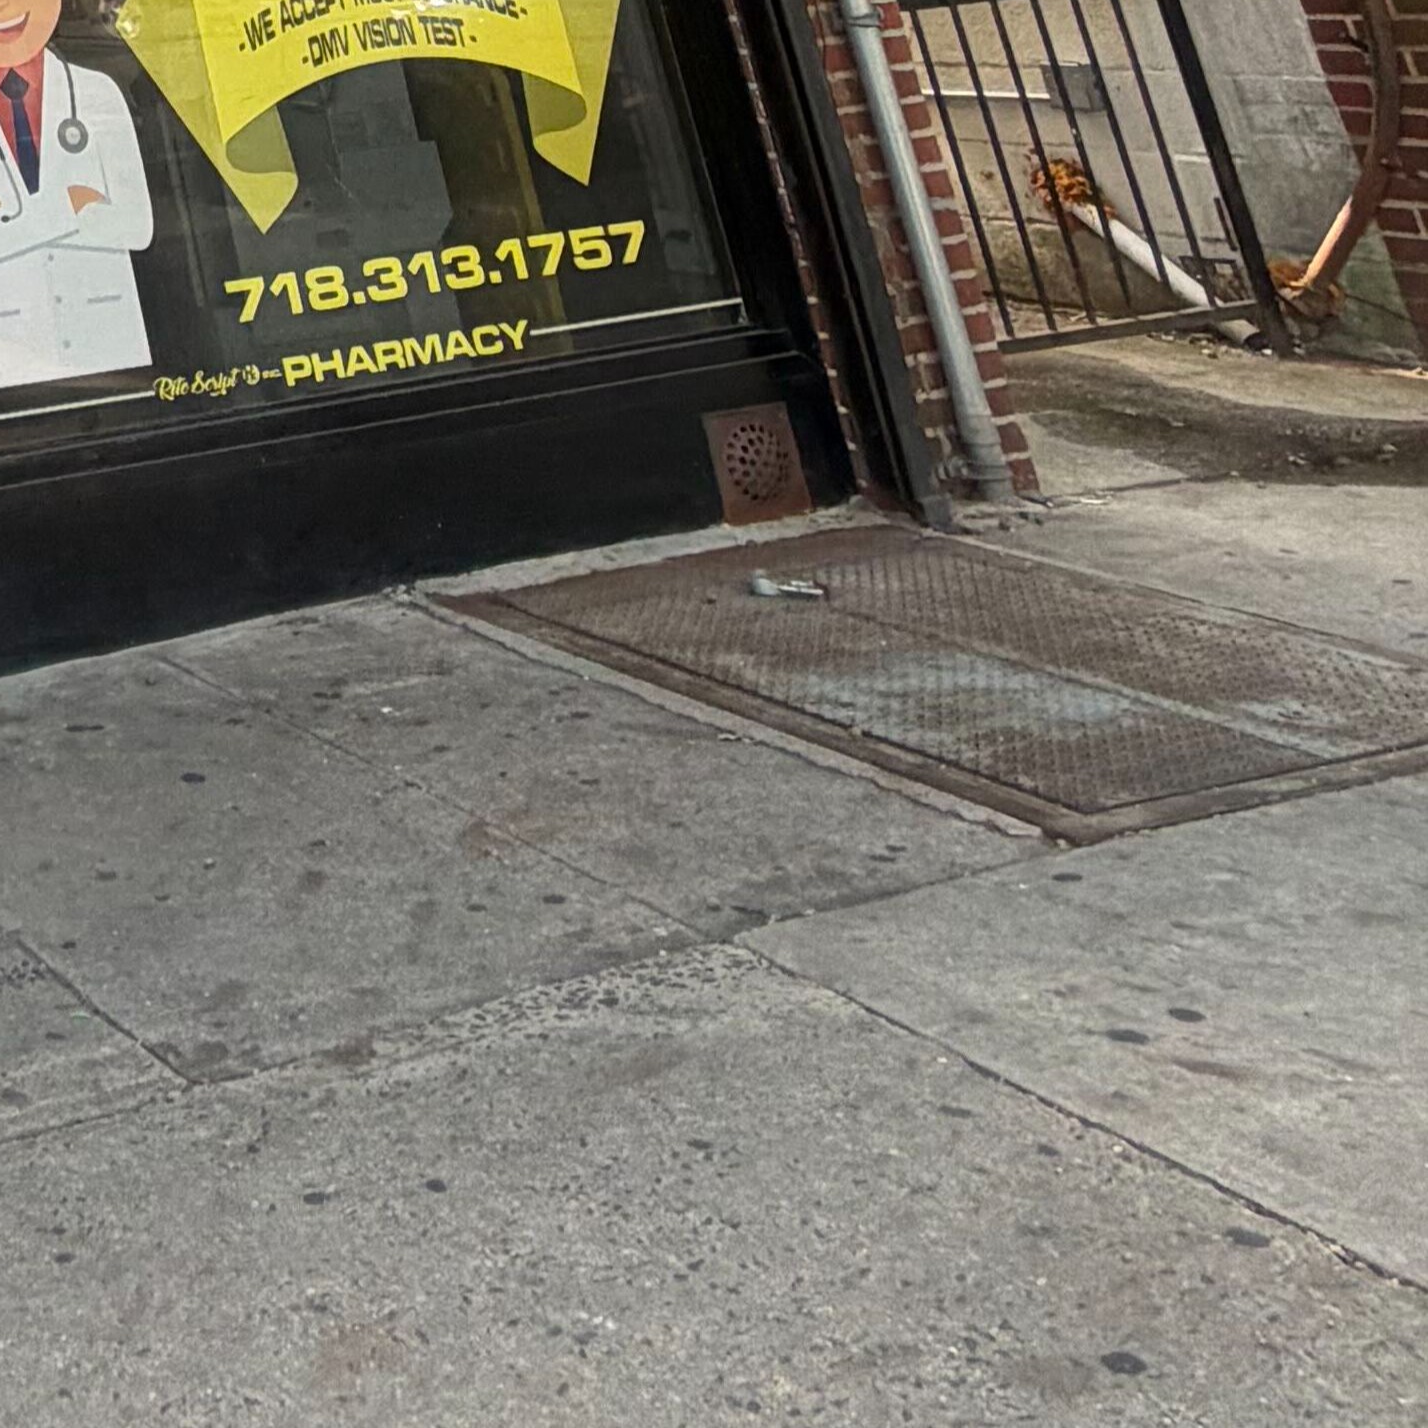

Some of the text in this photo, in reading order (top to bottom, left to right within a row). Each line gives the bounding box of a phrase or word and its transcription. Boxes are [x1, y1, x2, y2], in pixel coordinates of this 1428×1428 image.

[353, 17, 417, 51] VISION
[224, 220, 646, 323] 718.313.1757
[282, 320, 528, 387] PHARMACY
